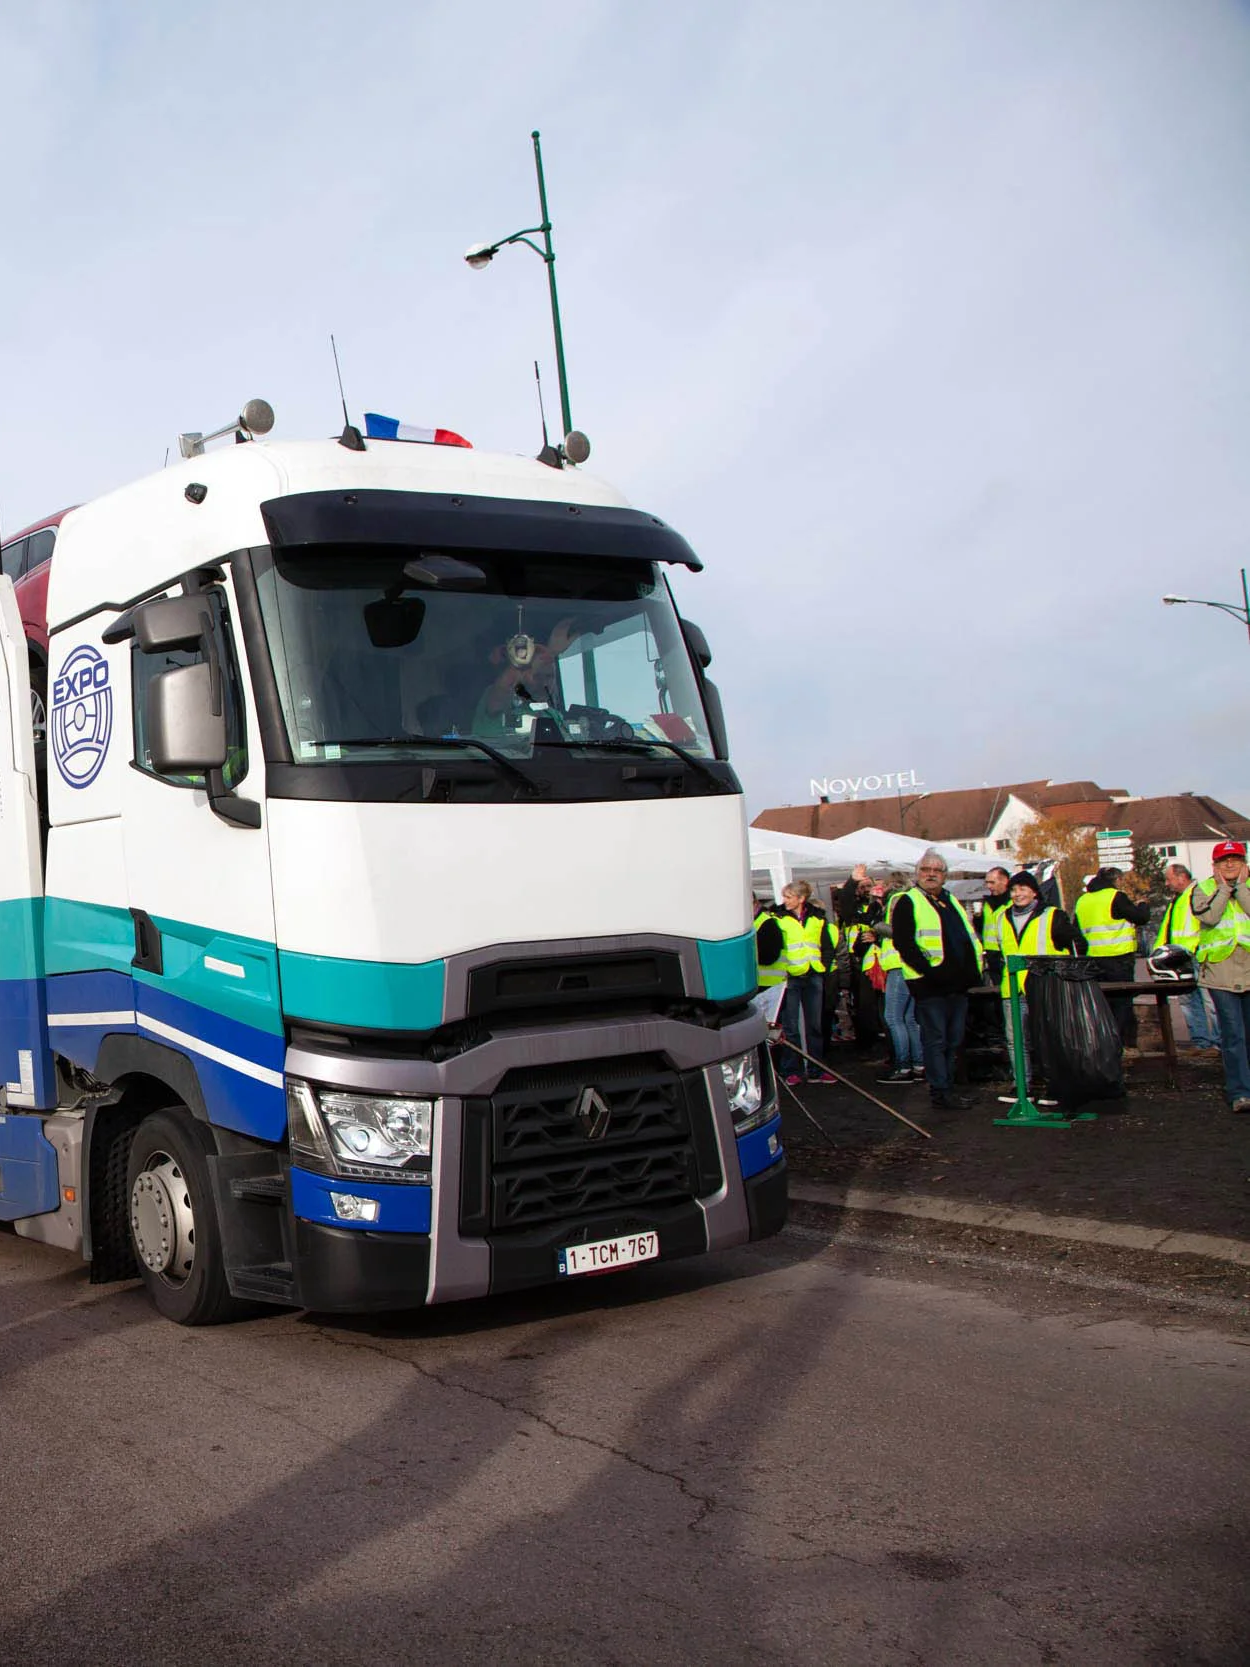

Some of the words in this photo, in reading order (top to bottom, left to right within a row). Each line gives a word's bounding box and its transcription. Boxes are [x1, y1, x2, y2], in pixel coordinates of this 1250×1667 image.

[53, 659, 109, 705] EXPO
[810, 769, 925, 797] NOVOTEL
[559, 1263, 566, 1272] B
[570, 1235, 655, 1270] 1-TCM-767
